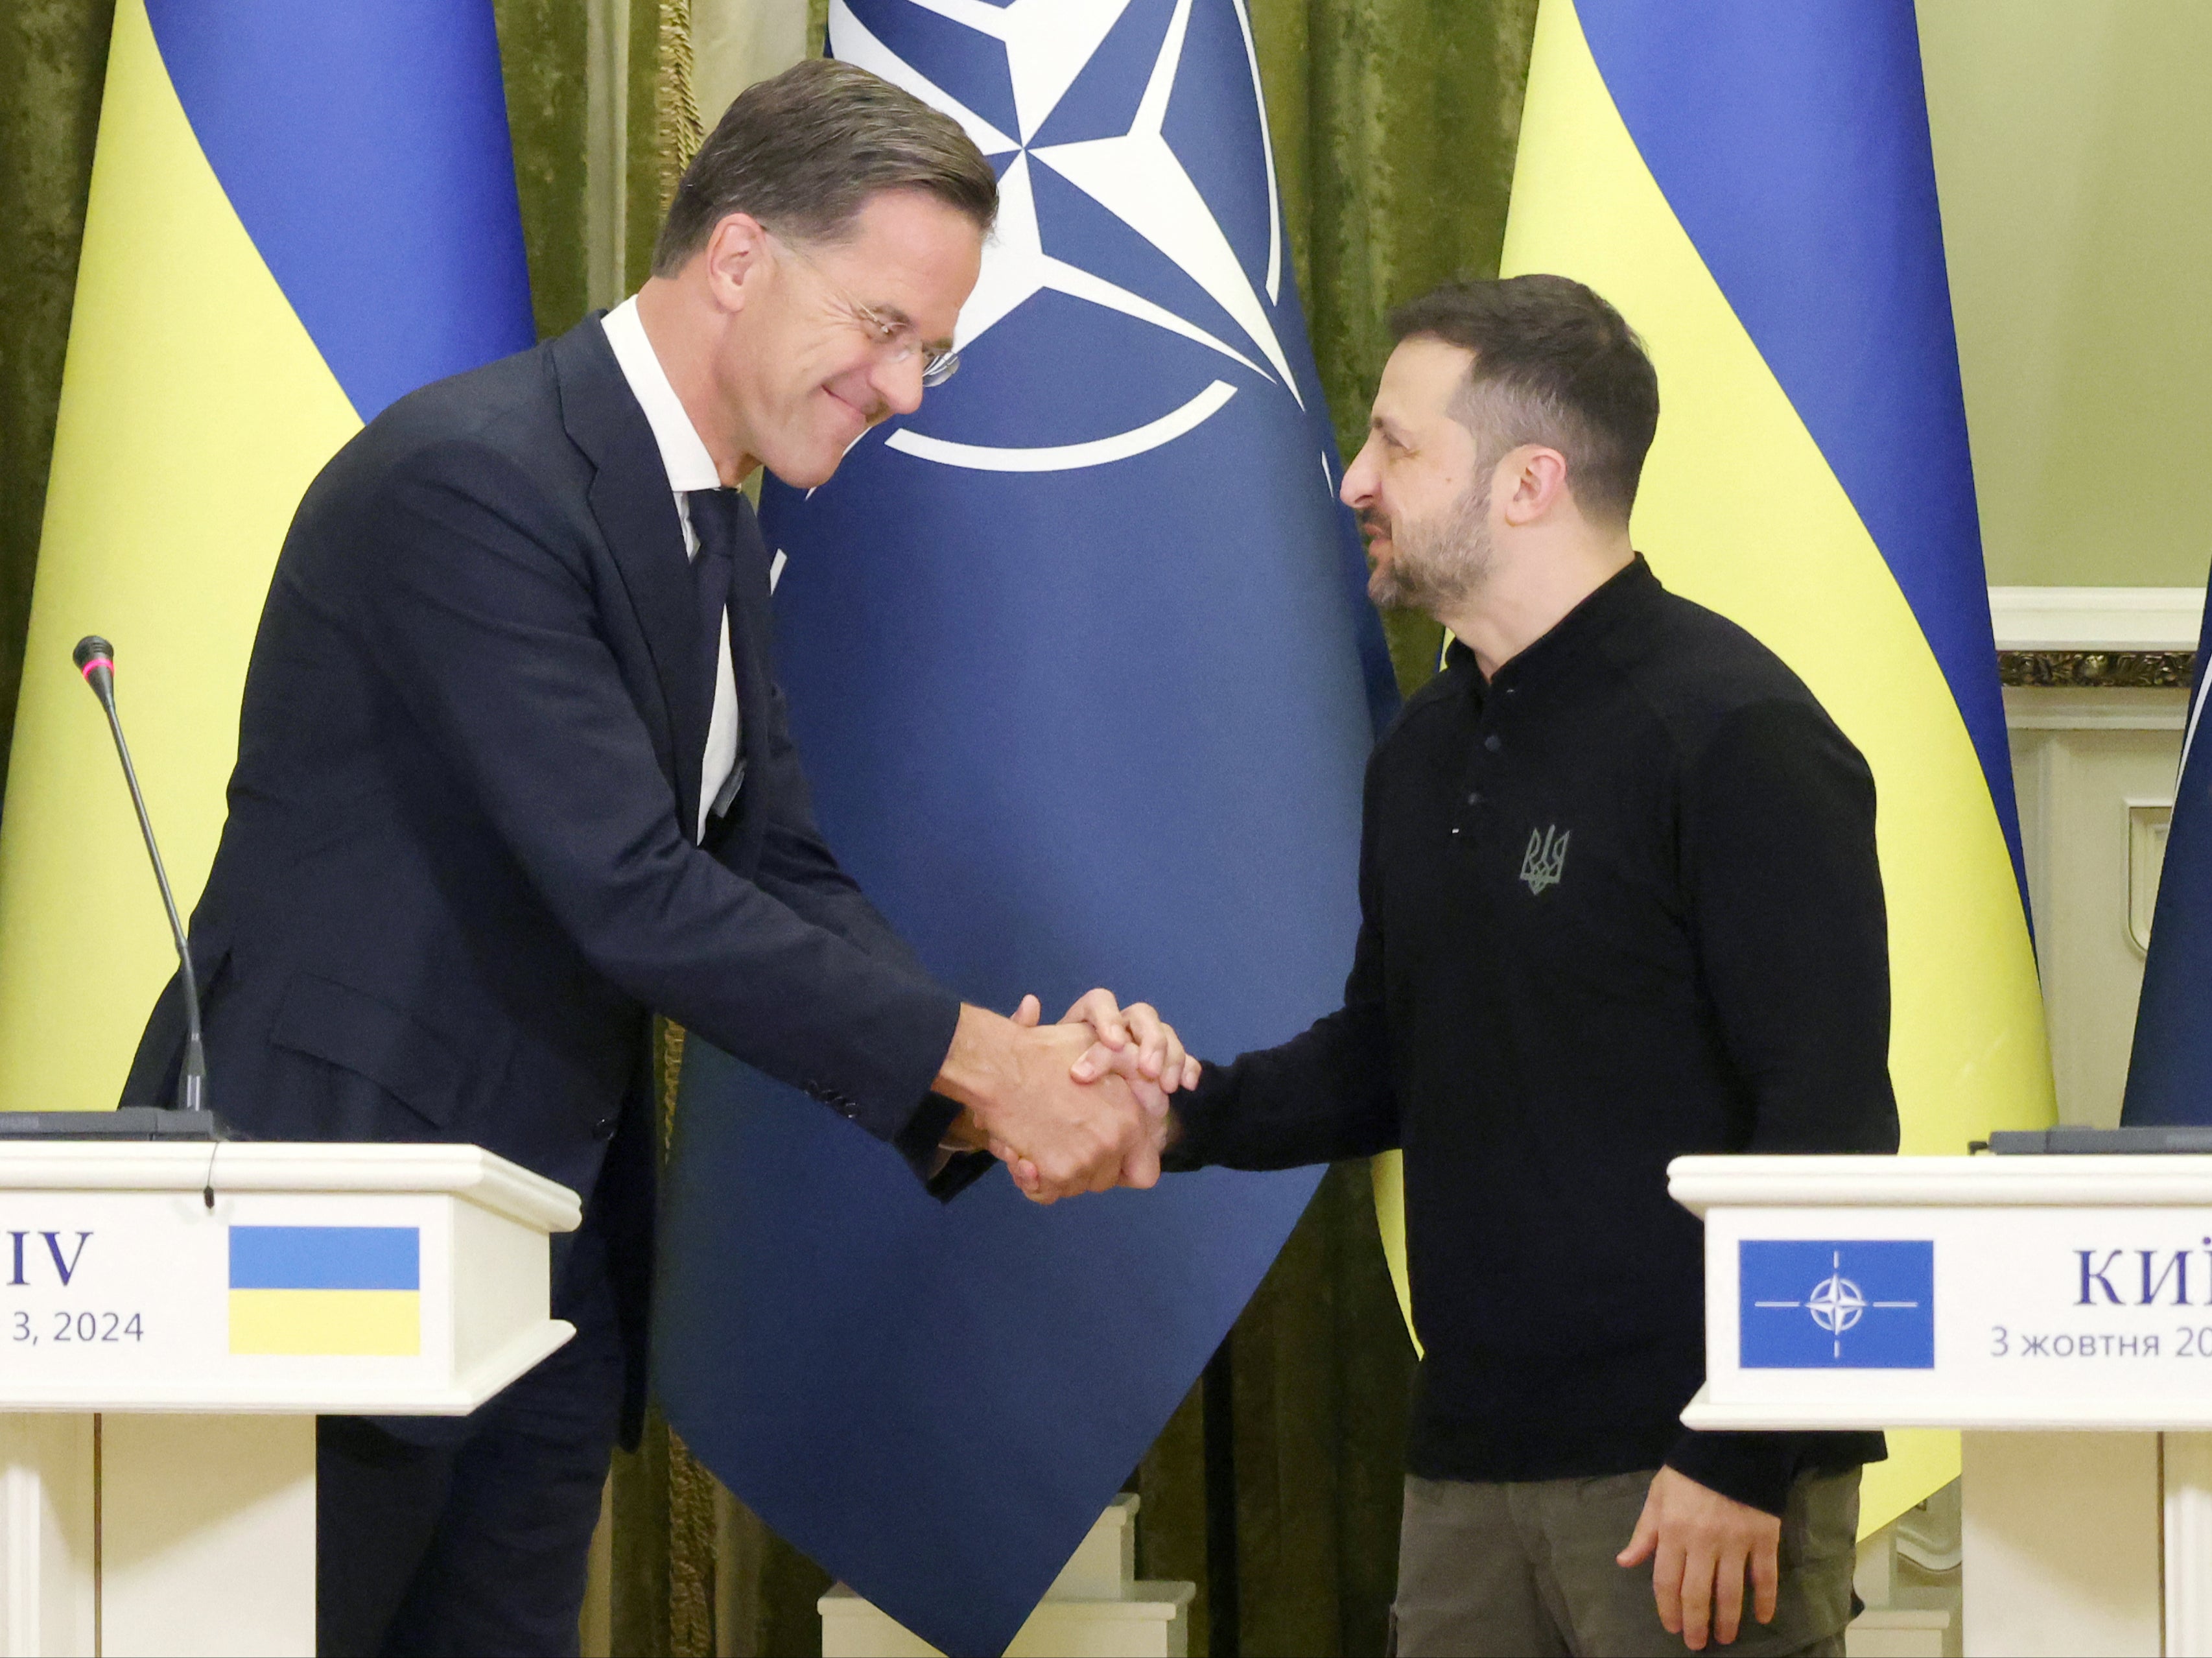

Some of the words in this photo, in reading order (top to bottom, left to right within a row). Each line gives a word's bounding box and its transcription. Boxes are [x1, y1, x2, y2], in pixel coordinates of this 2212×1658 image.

[6, 1230, 95, 1287] IV
[13, 1310, 38, 1346] 3,
[53, 1310, 144, 1342] 2024
[1992, 1325, 2009, 1356] 3
[2021, 1334, 2159, 1357] жовтня
